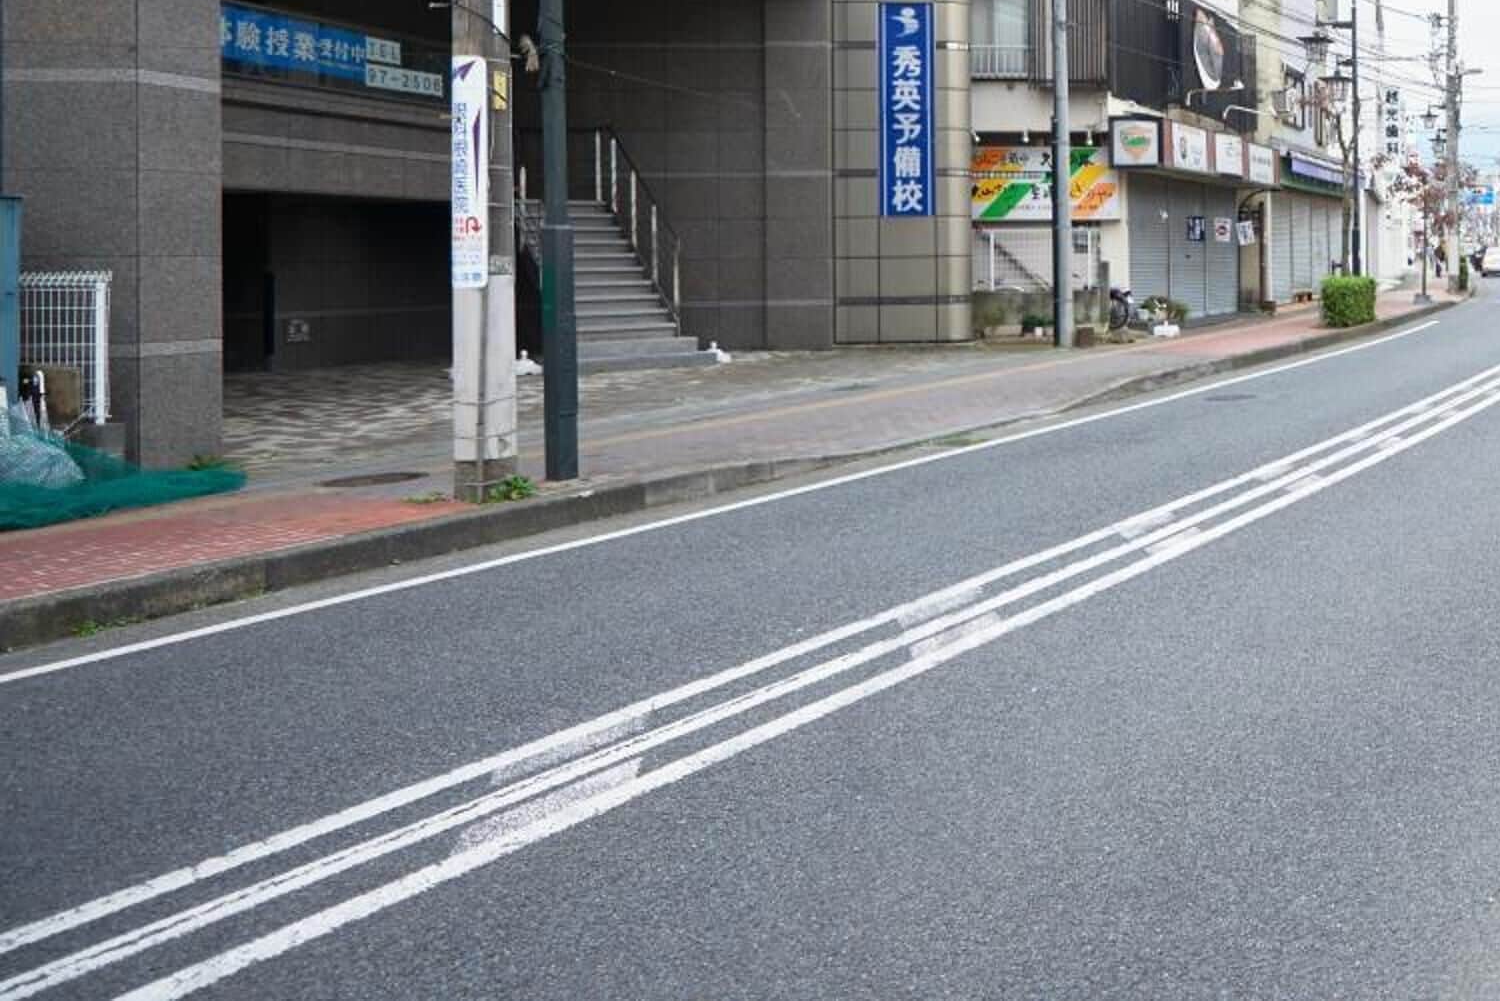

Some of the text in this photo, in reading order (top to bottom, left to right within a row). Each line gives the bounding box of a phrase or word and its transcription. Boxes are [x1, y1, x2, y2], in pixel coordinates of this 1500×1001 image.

[892, 45, 924, 213] 秀英予備校
